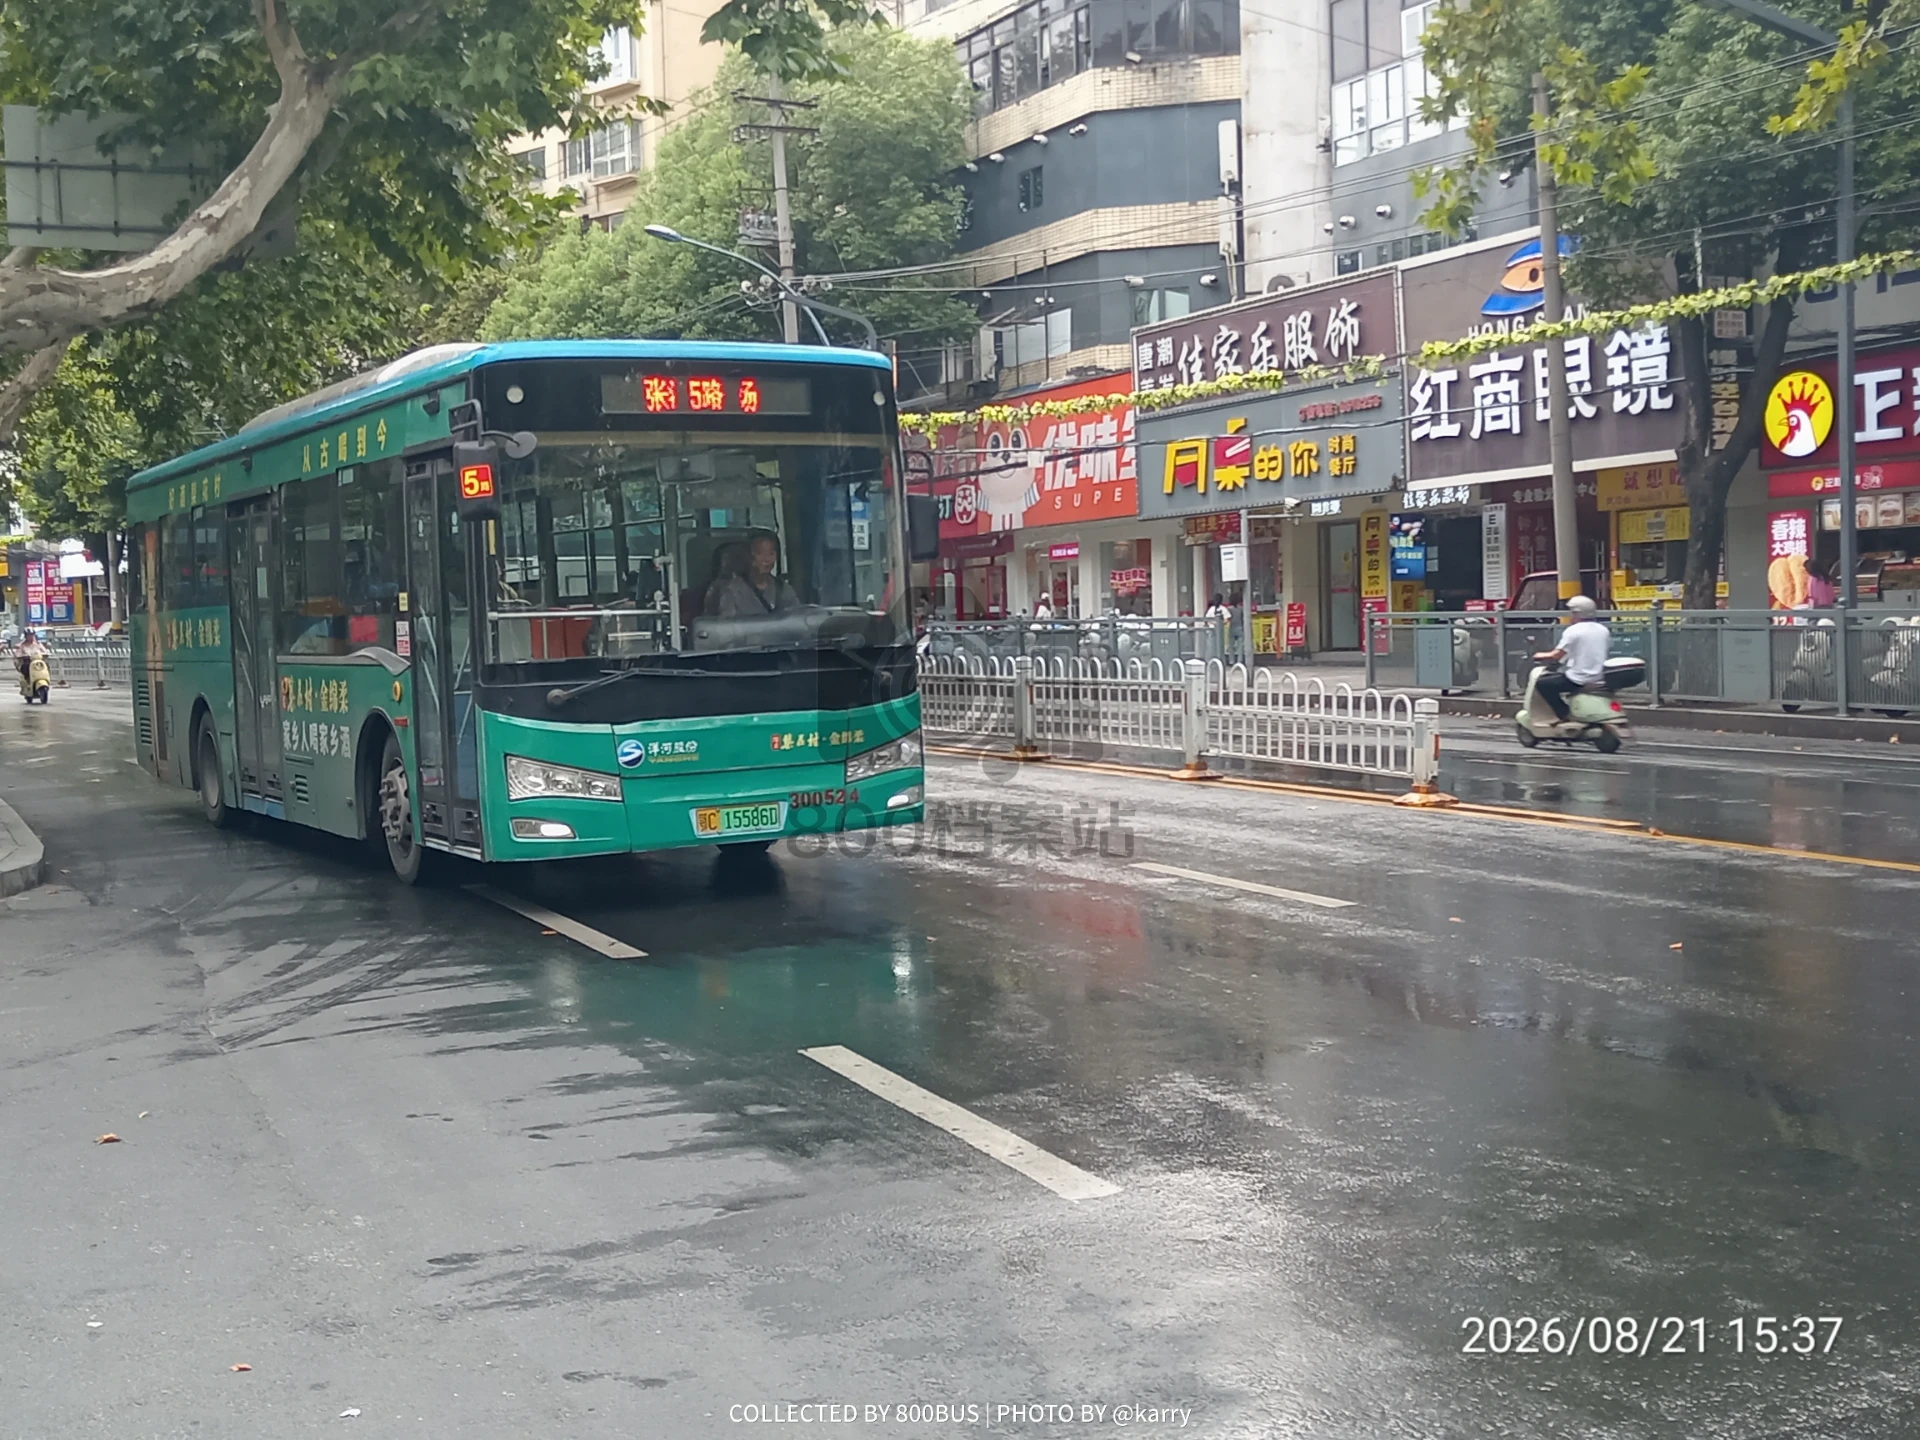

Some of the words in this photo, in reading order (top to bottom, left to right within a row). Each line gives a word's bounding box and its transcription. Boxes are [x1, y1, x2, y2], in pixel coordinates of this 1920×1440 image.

[1138, 336, 1174, 372] 唐潮
[1177, 298, 1361, 388] 佳家乐服饰
[688, 376, 726, 412] 5路
[1409, 320, 1675, 442] 红商眼镜
[1163, 417, 1320, 495] 同桌的你
[1771, 517, 1807, 541] 香辣
[282, 719, 352, 760] 家乡人喝家乡酒
[788, 788, 860, 810] 300524
